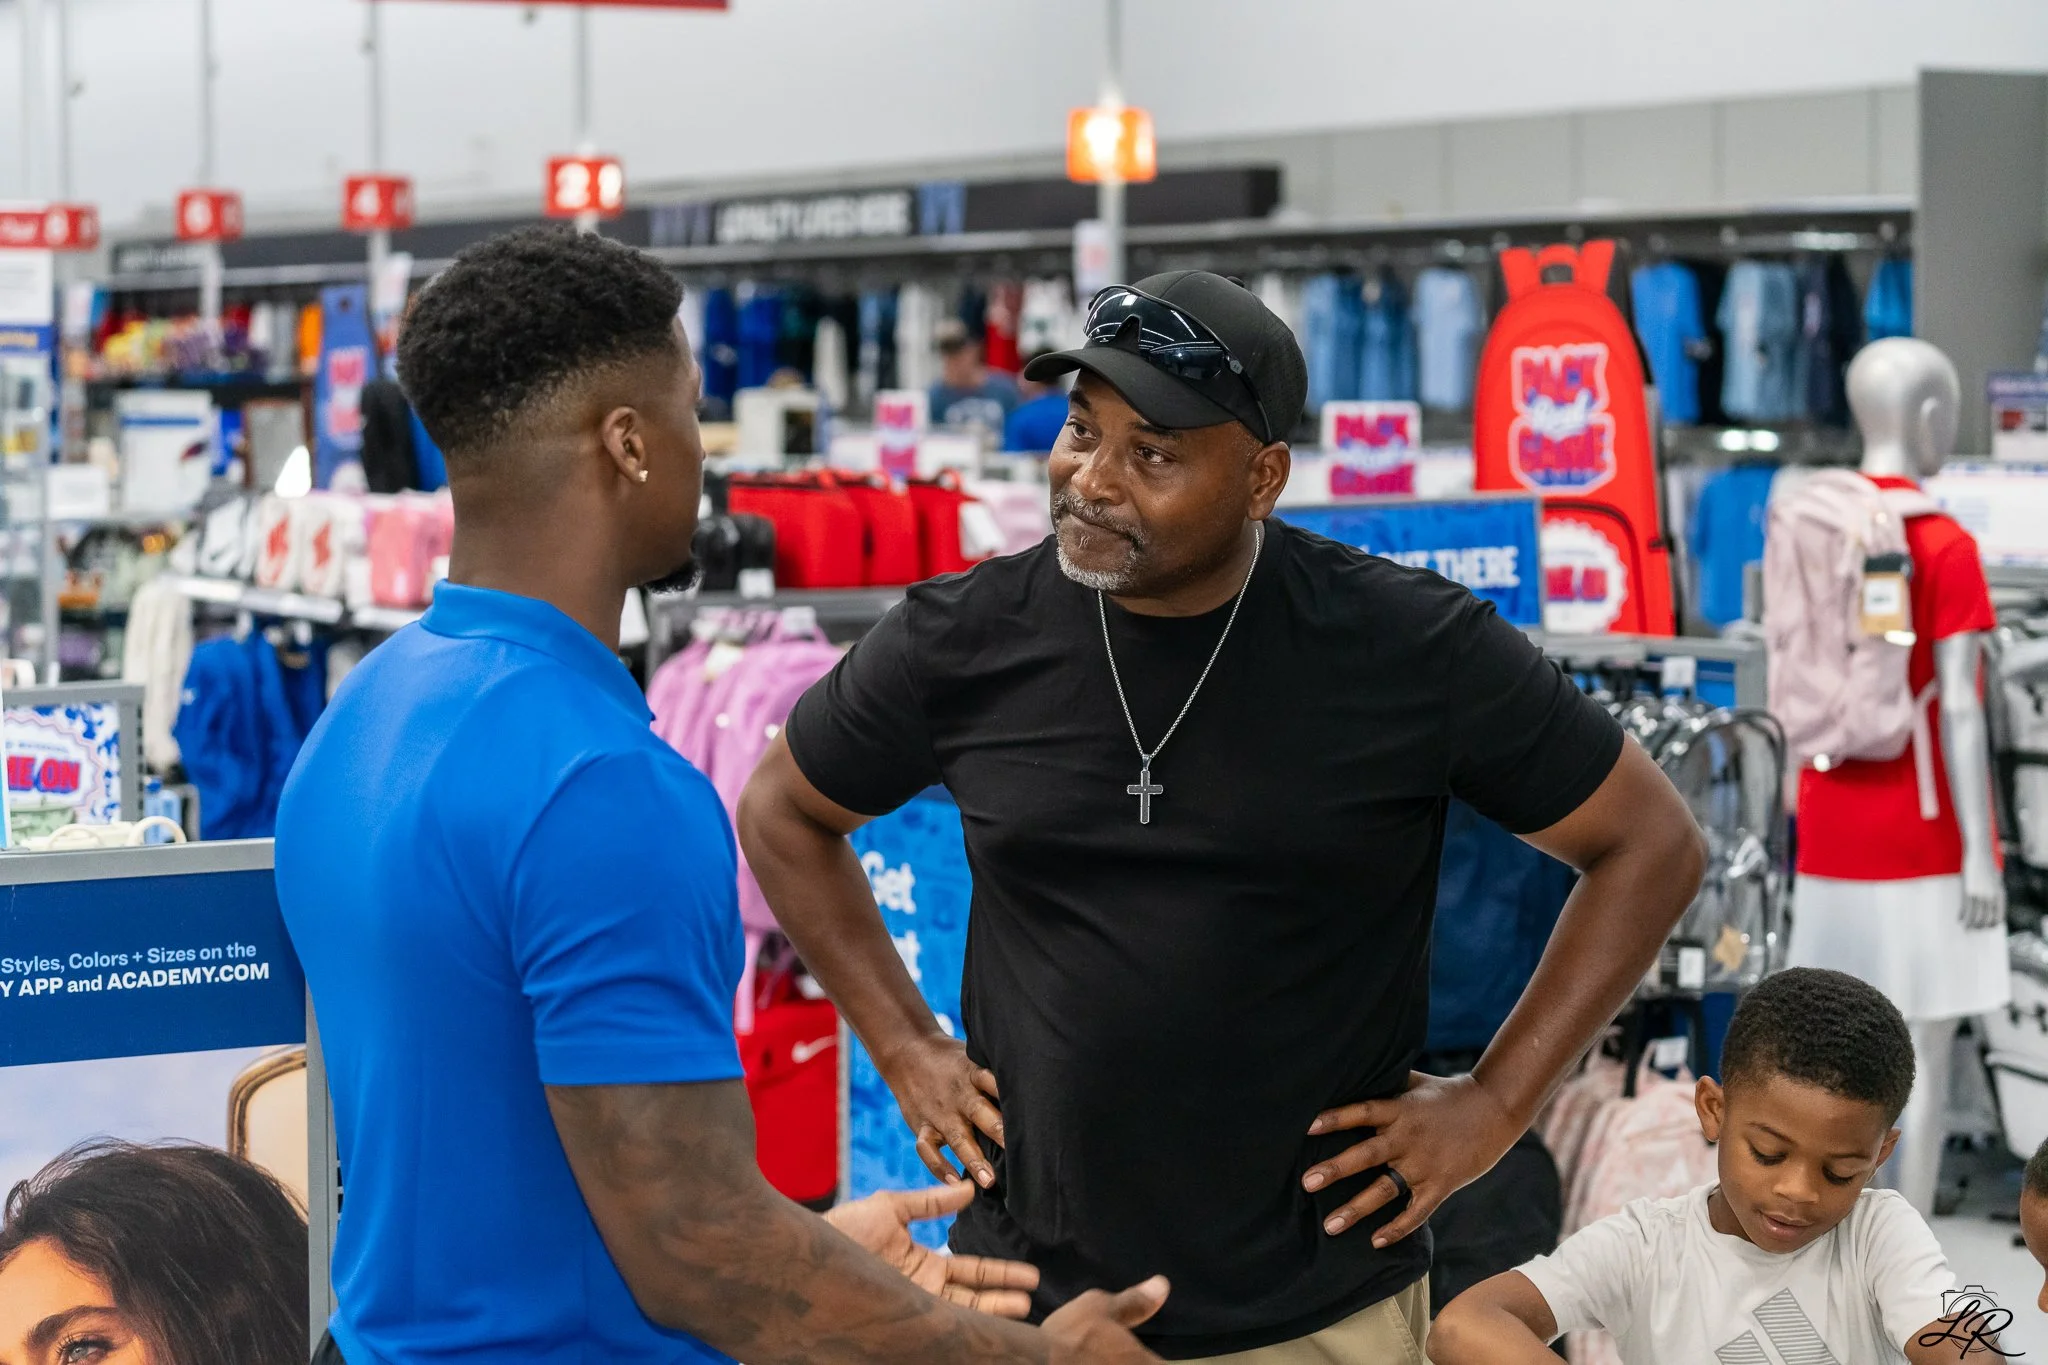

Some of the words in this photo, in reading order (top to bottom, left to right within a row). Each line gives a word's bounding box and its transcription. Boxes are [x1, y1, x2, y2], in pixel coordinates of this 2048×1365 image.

[40, 758, 81, 794] ON
[1, 956, 66, 976] Styles,
[69, 951, 129, 970] Colors
[147, 947, 196, 965] Sizes
[199, 946, 222, 961] on
[226, 942, 257, 959] the
[18, 977, 64, 997] APP
[67, 974, 103, 993] and
[107, 962, 270, 990] ACADEMY.COM
